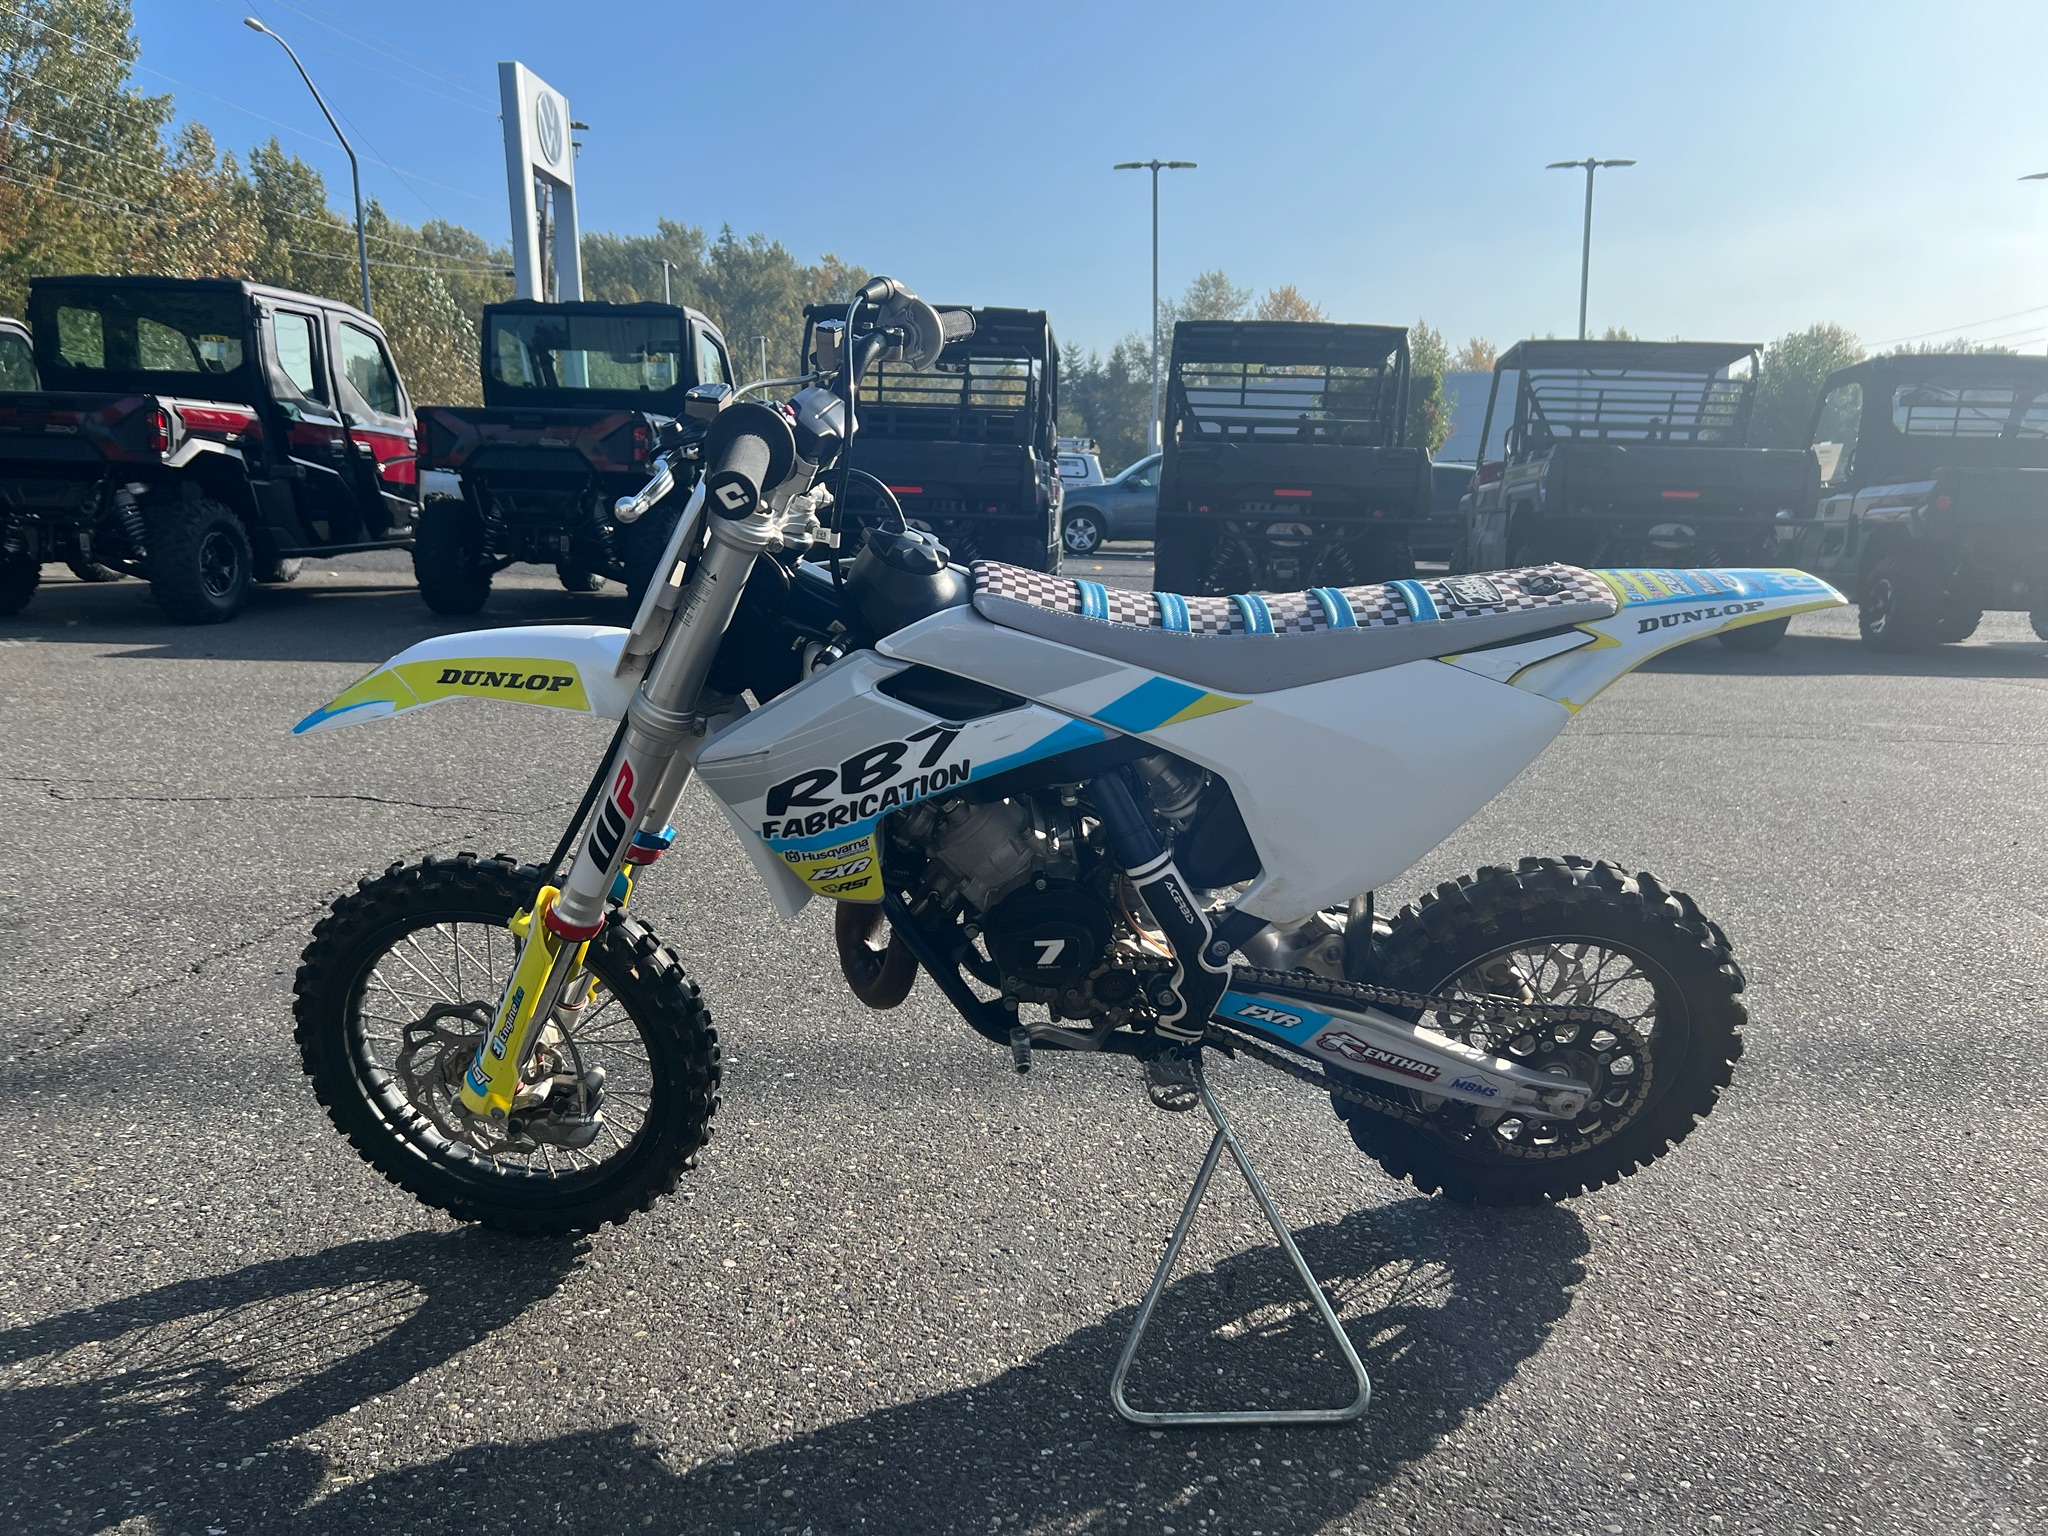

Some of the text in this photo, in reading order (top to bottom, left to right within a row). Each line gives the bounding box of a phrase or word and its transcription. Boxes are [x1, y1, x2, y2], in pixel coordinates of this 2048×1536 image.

[1637, 600, 1765, 634] DUNLOP
[436, 668, 574, 692] DUNLOP
[765, 723, 967, 817] RB7
[762, 759, 971, 840] FABRICATION
[802, 838, 870, 862] Husqvarna
[808, 856, 873, 881] FXR
[838, 876, 872, 893] RST
[1033, 939, 1065, 965] 7
[1234, 1002, 1304, 1028] FXR
[1317, 1032, 1438, 1078] RENTHAL
[1451, 1078, 1498, 1097] MBMS
